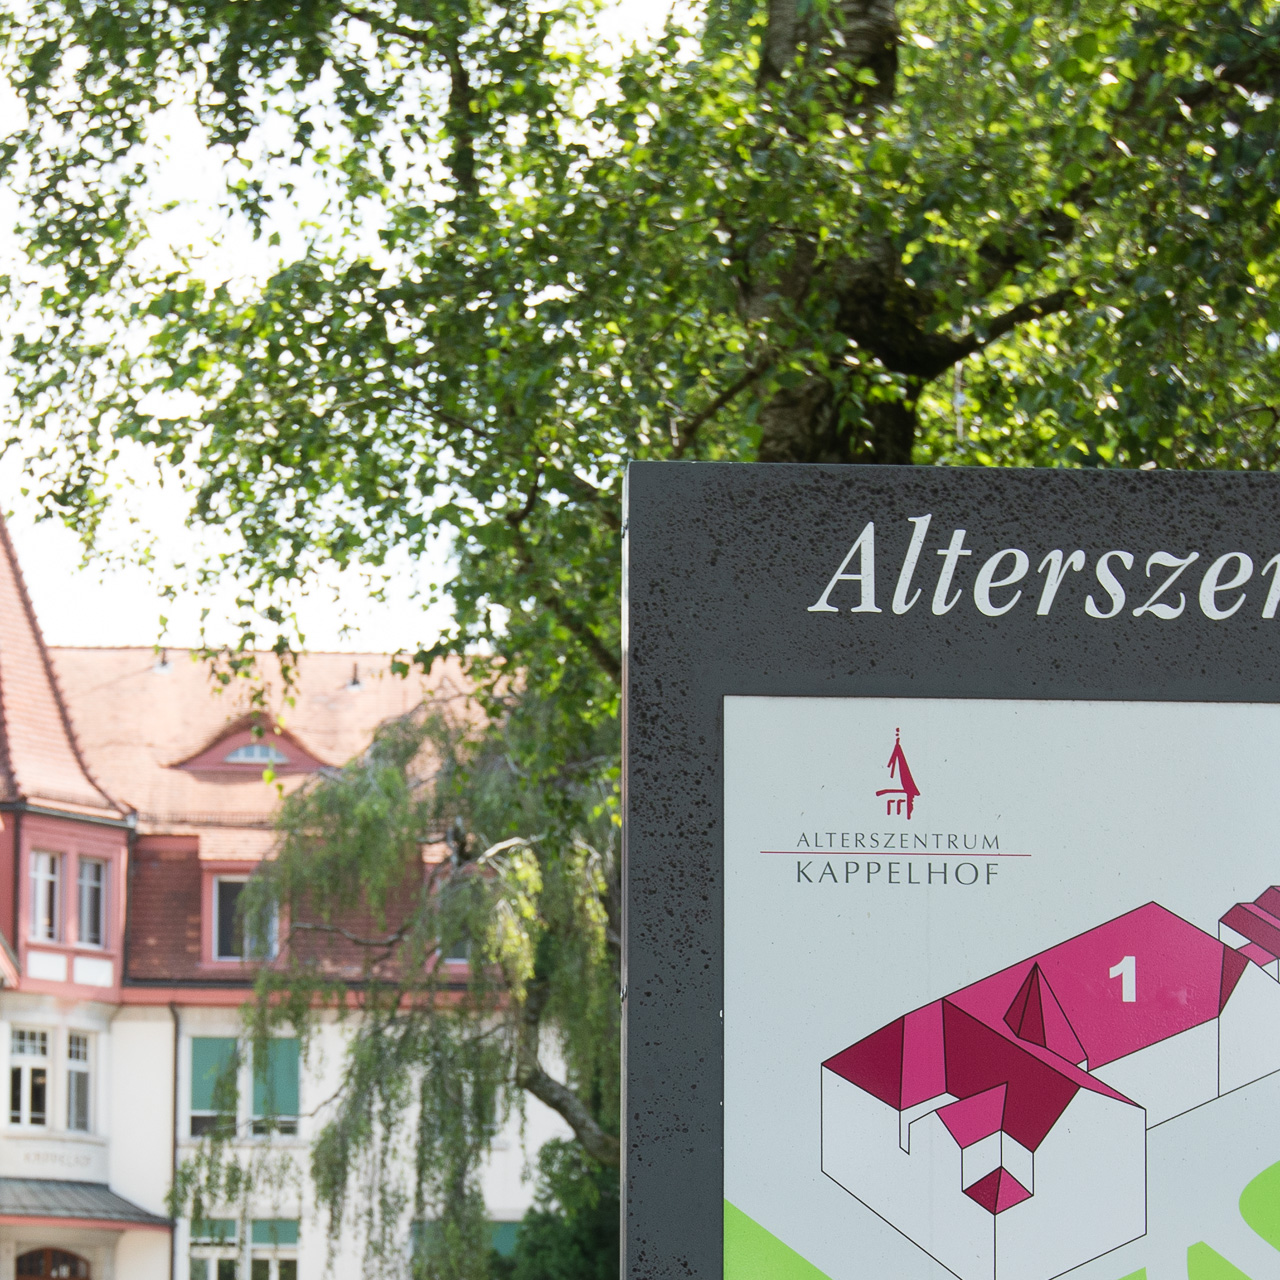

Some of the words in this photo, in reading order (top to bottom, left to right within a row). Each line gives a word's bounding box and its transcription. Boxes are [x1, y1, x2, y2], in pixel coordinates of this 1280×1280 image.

[796, 831, 1001, 851] ALTERSZENTRUM
[795, 860, 1000, 886] KAPPELHOF
[1107, 954, 1138, 1004] 1
